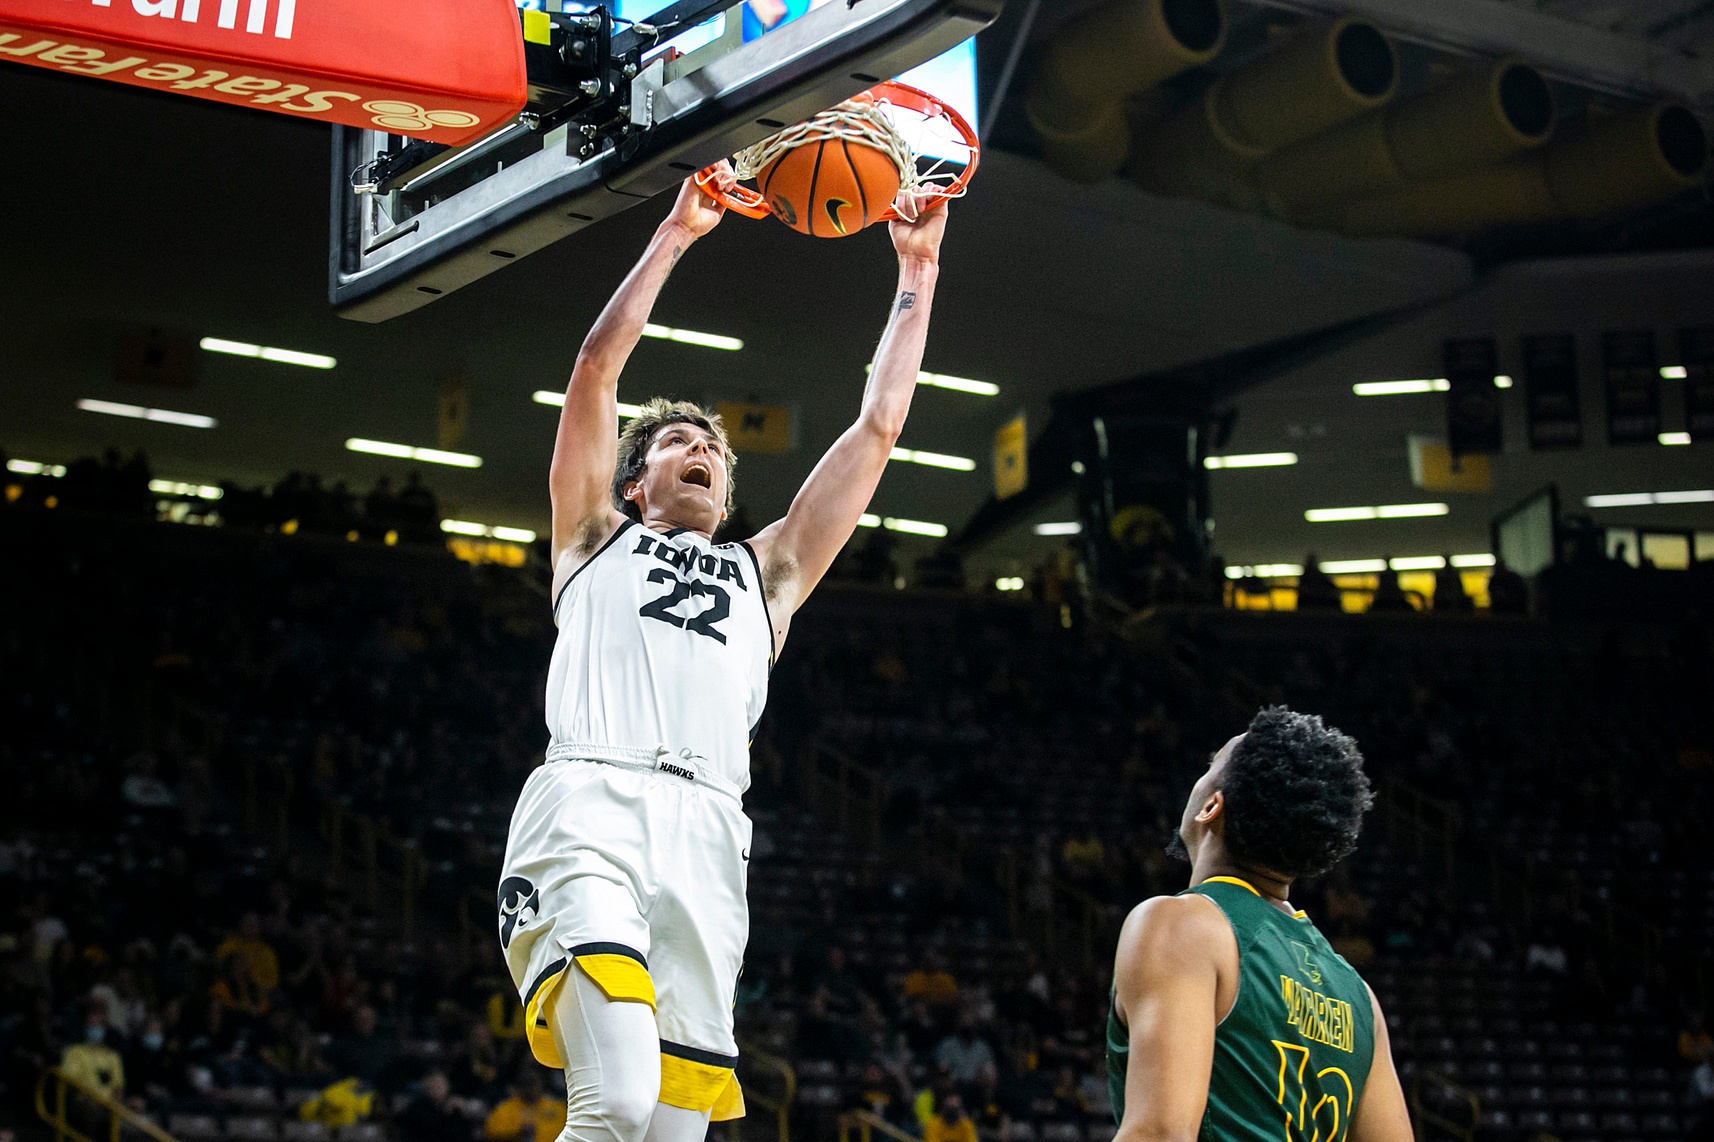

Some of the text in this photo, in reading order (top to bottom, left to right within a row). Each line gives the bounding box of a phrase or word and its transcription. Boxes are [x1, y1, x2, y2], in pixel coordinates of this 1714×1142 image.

[632, 534, 748, 592] IOWA
[639, 568, 731, 646] 22
[659, 761, 695, 781] HAWKS
[1280, 974, 1354, 1054] WARREN
